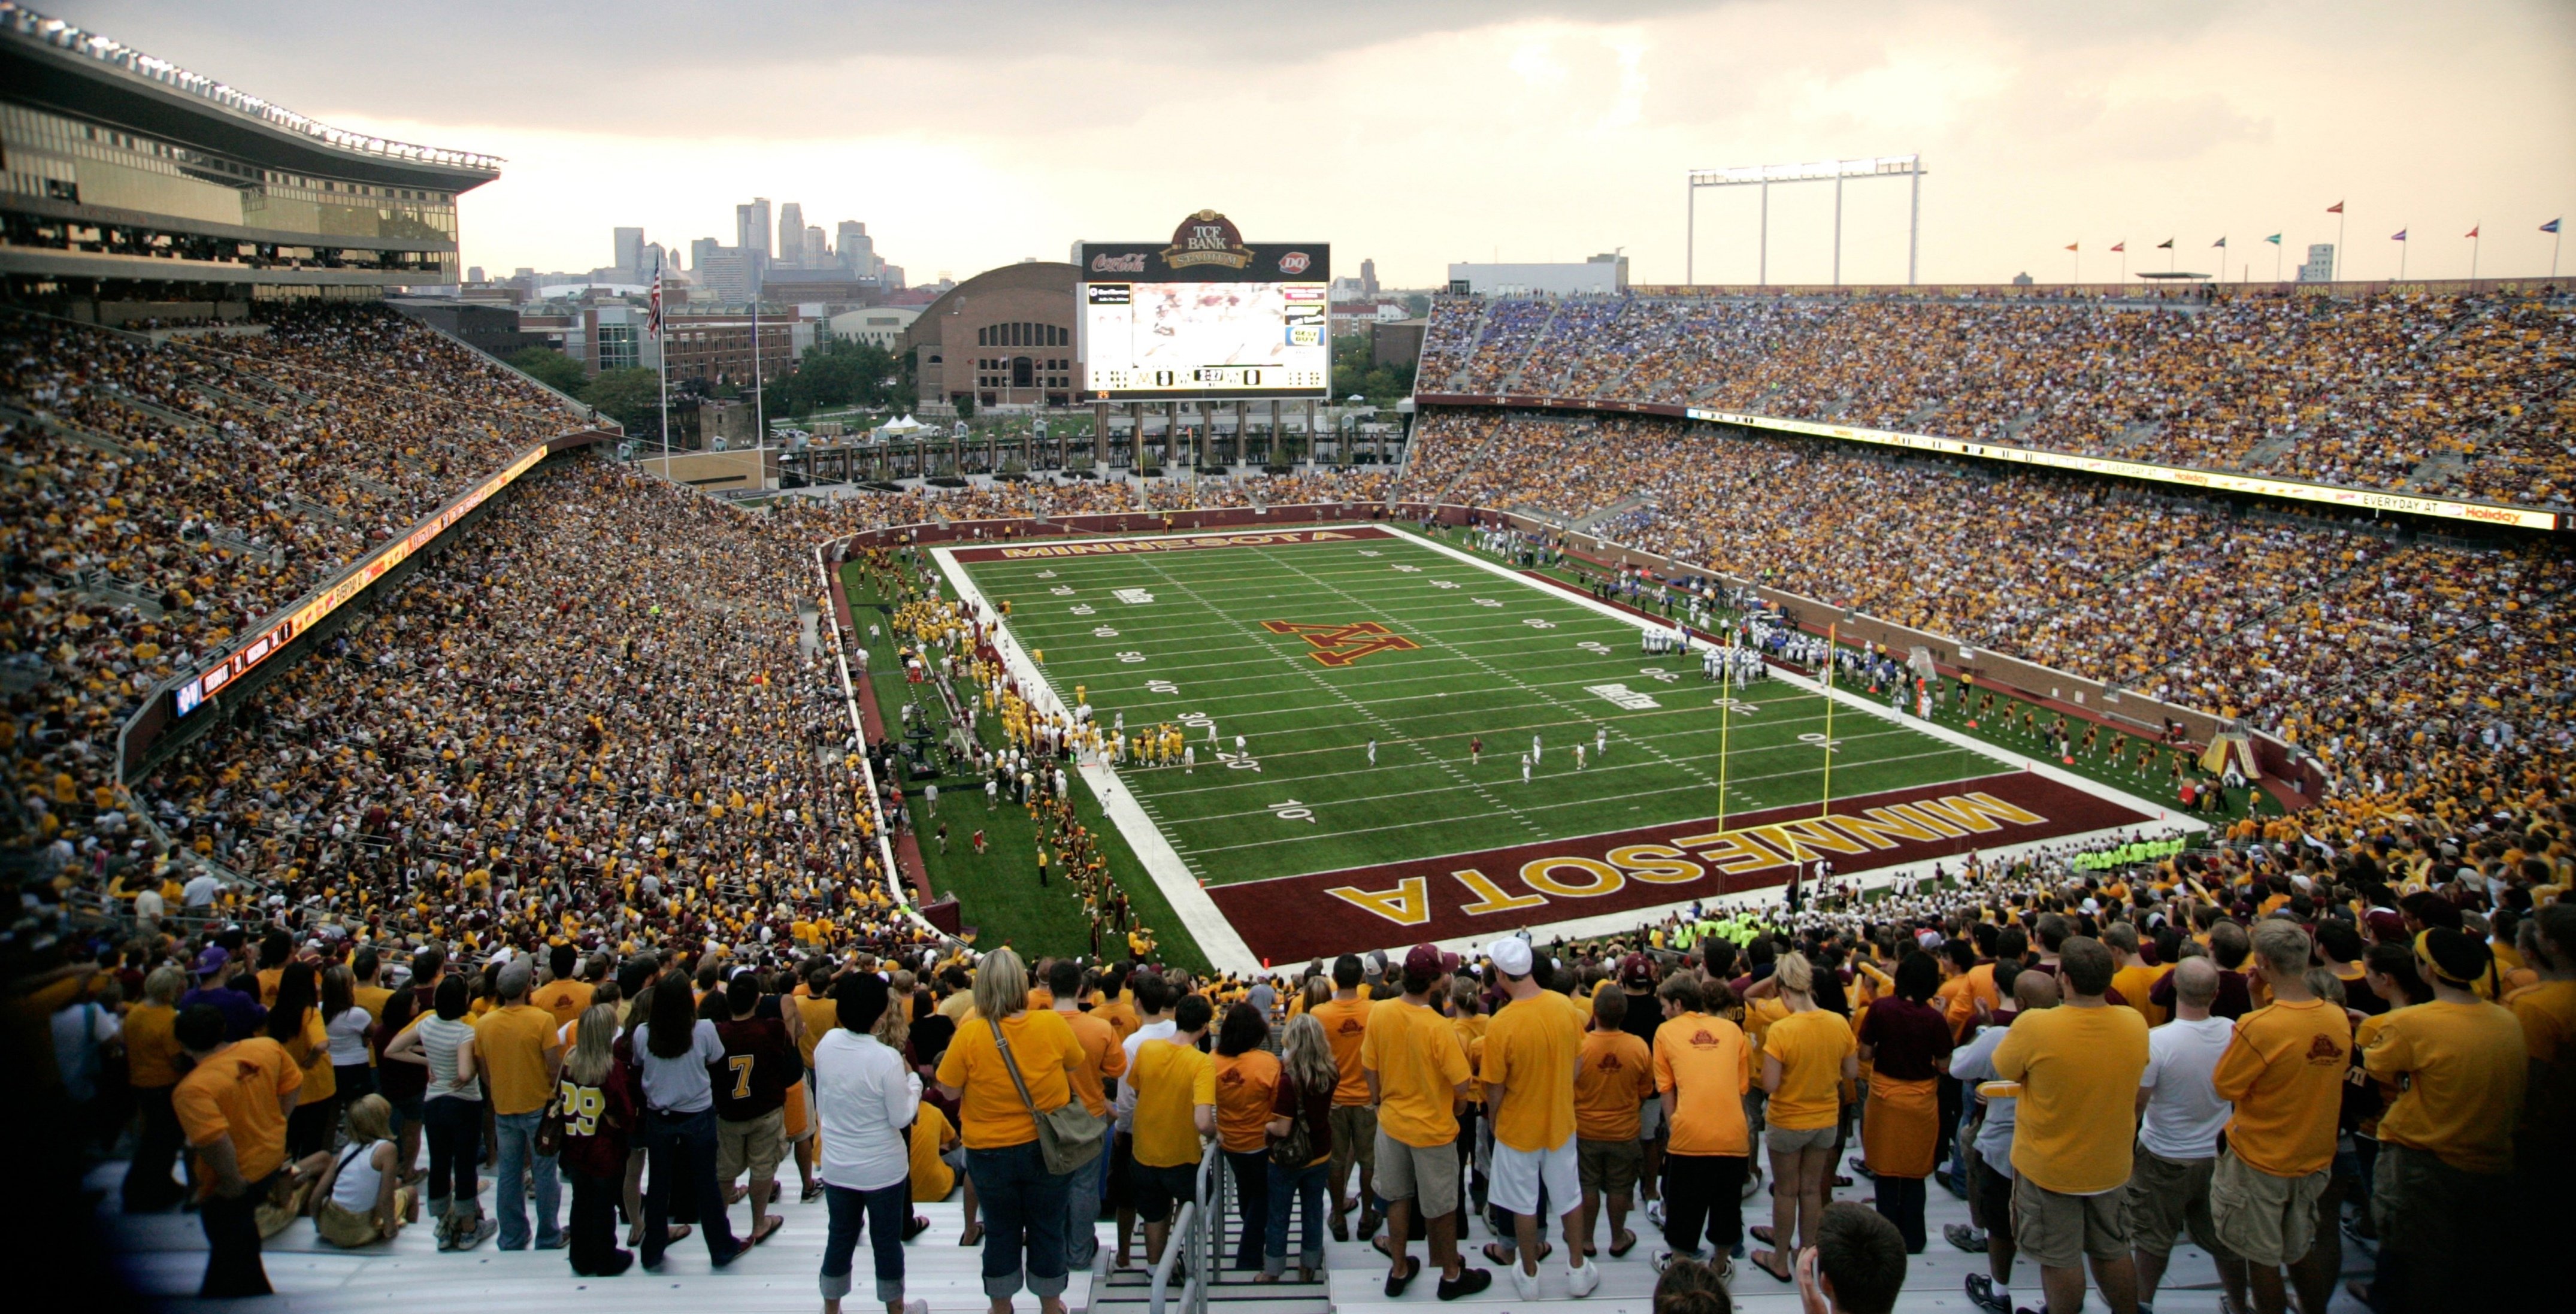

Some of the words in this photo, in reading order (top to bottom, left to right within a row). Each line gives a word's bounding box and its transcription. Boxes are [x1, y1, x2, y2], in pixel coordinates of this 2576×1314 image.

[1193, 226, 1221, 238] TCF
[1188, 238, 1227, 250] BANK
[1176, 253, 1239, 265] STADIUM
[1284, 256, 1306, 269] DQ
[2296, 285, 2329, 296] 2006
[2388, 284, 2426, 294] 2008
[1247, 370, 1257, 384] 0
[2174, 471, 2209, 486] Holiday
[2363, 495, 2420, 511] EVERYDAY
[2424, 502, 2438, 513] AT
[2465, 506, 2523, 525] Holiday
[1002, 531, 1355, 558] MINNESOTA
[1522, 619, 1556, 628] 50
[1115, 652, 1146, 662] 50
[1145, 679, 1178, 693] 40
[1712, 698, 1760, 712] 20
[1177, 712, 1214, 728] 30
[1215, 751, 1260, 770] 20
[1267, 799, 1313, 821] 10
[1324, 791, 2050, 927] MINNESOTA
[729, 1054, 754, 1100] 7
